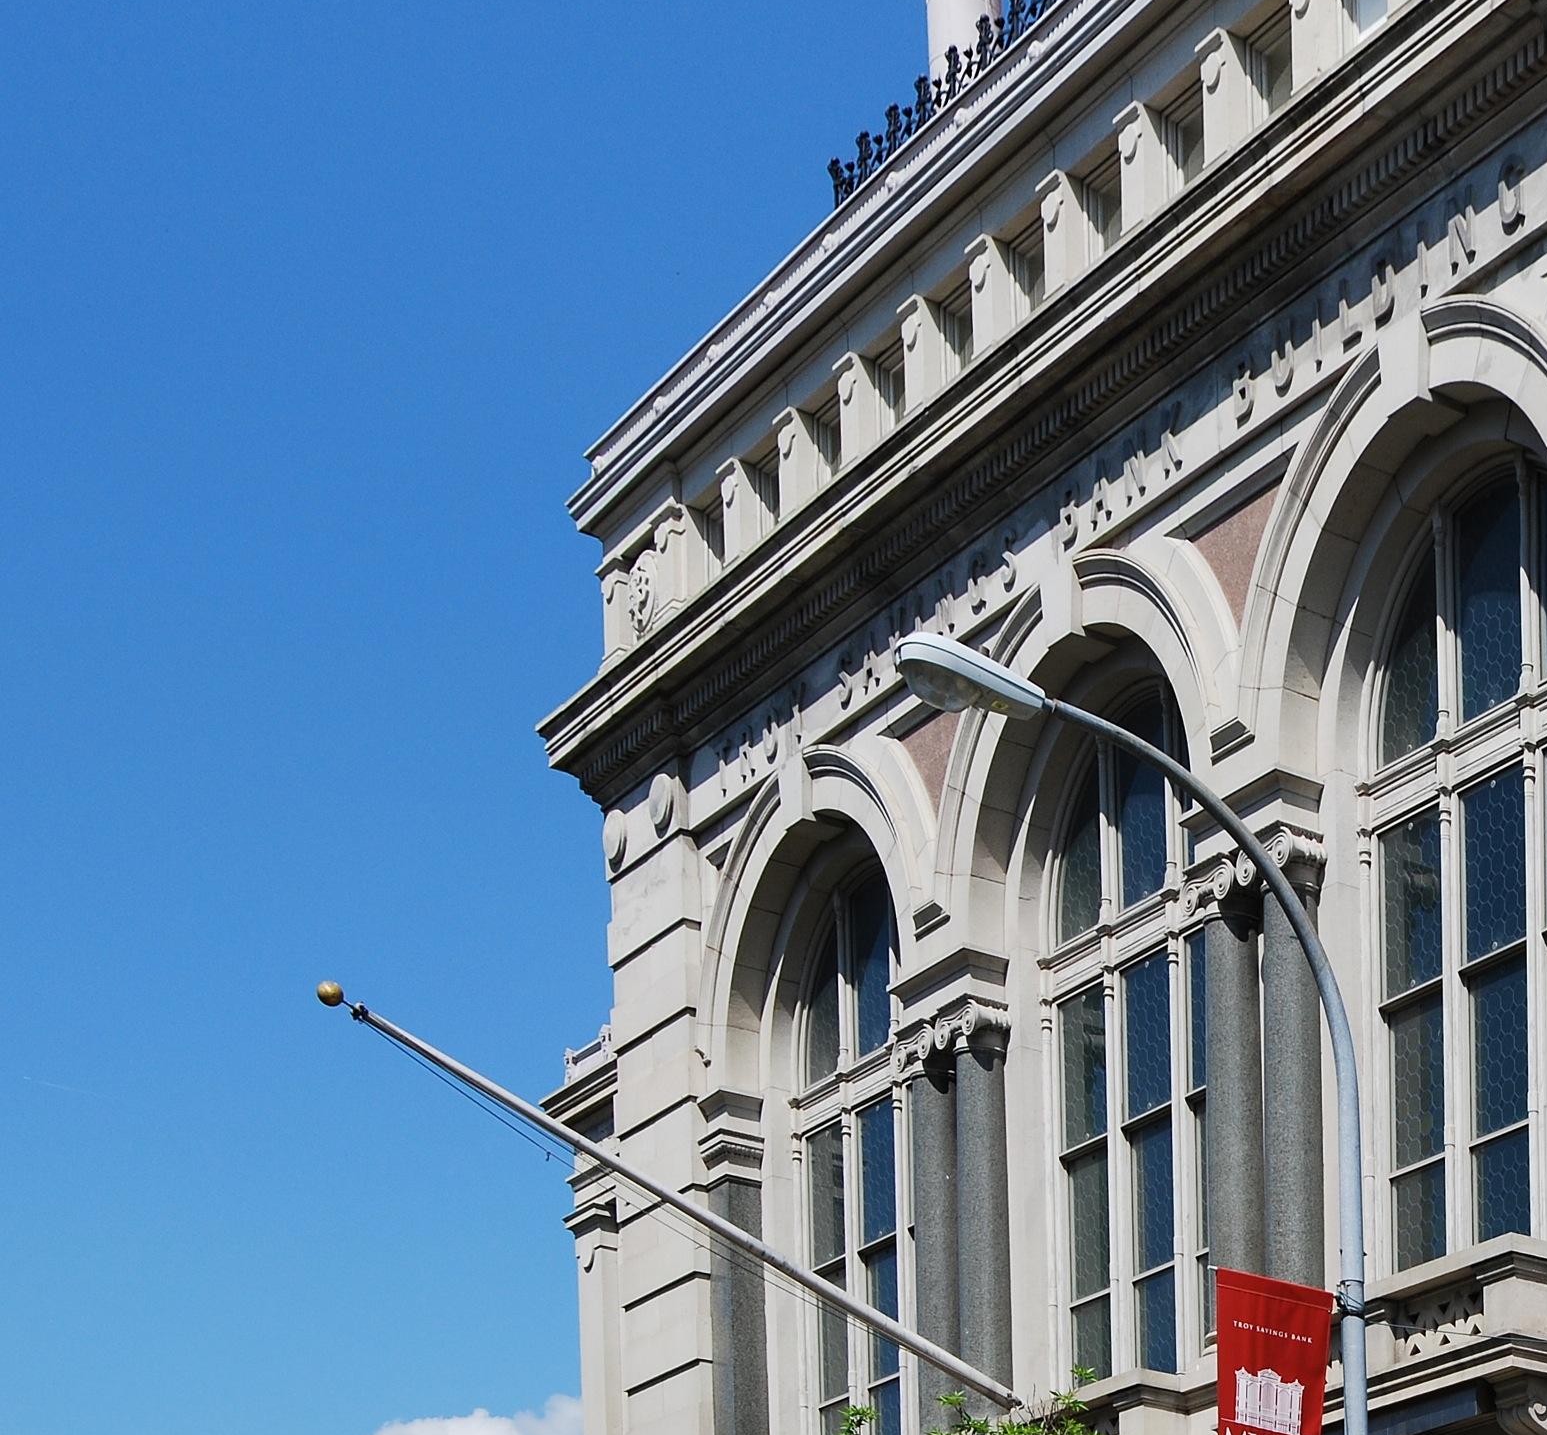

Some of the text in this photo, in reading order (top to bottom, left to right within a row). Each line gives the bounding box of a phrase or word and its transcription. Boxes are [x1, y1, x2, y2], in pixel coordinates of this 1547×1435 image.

[715, 678, 806, 798] TROY
[1050, 401, 1183, 556] BANK
[1232, 154, 1527, 431] BUILDING
[1233, 1320, 1313, 1344] TROY SAVINGS BANK
